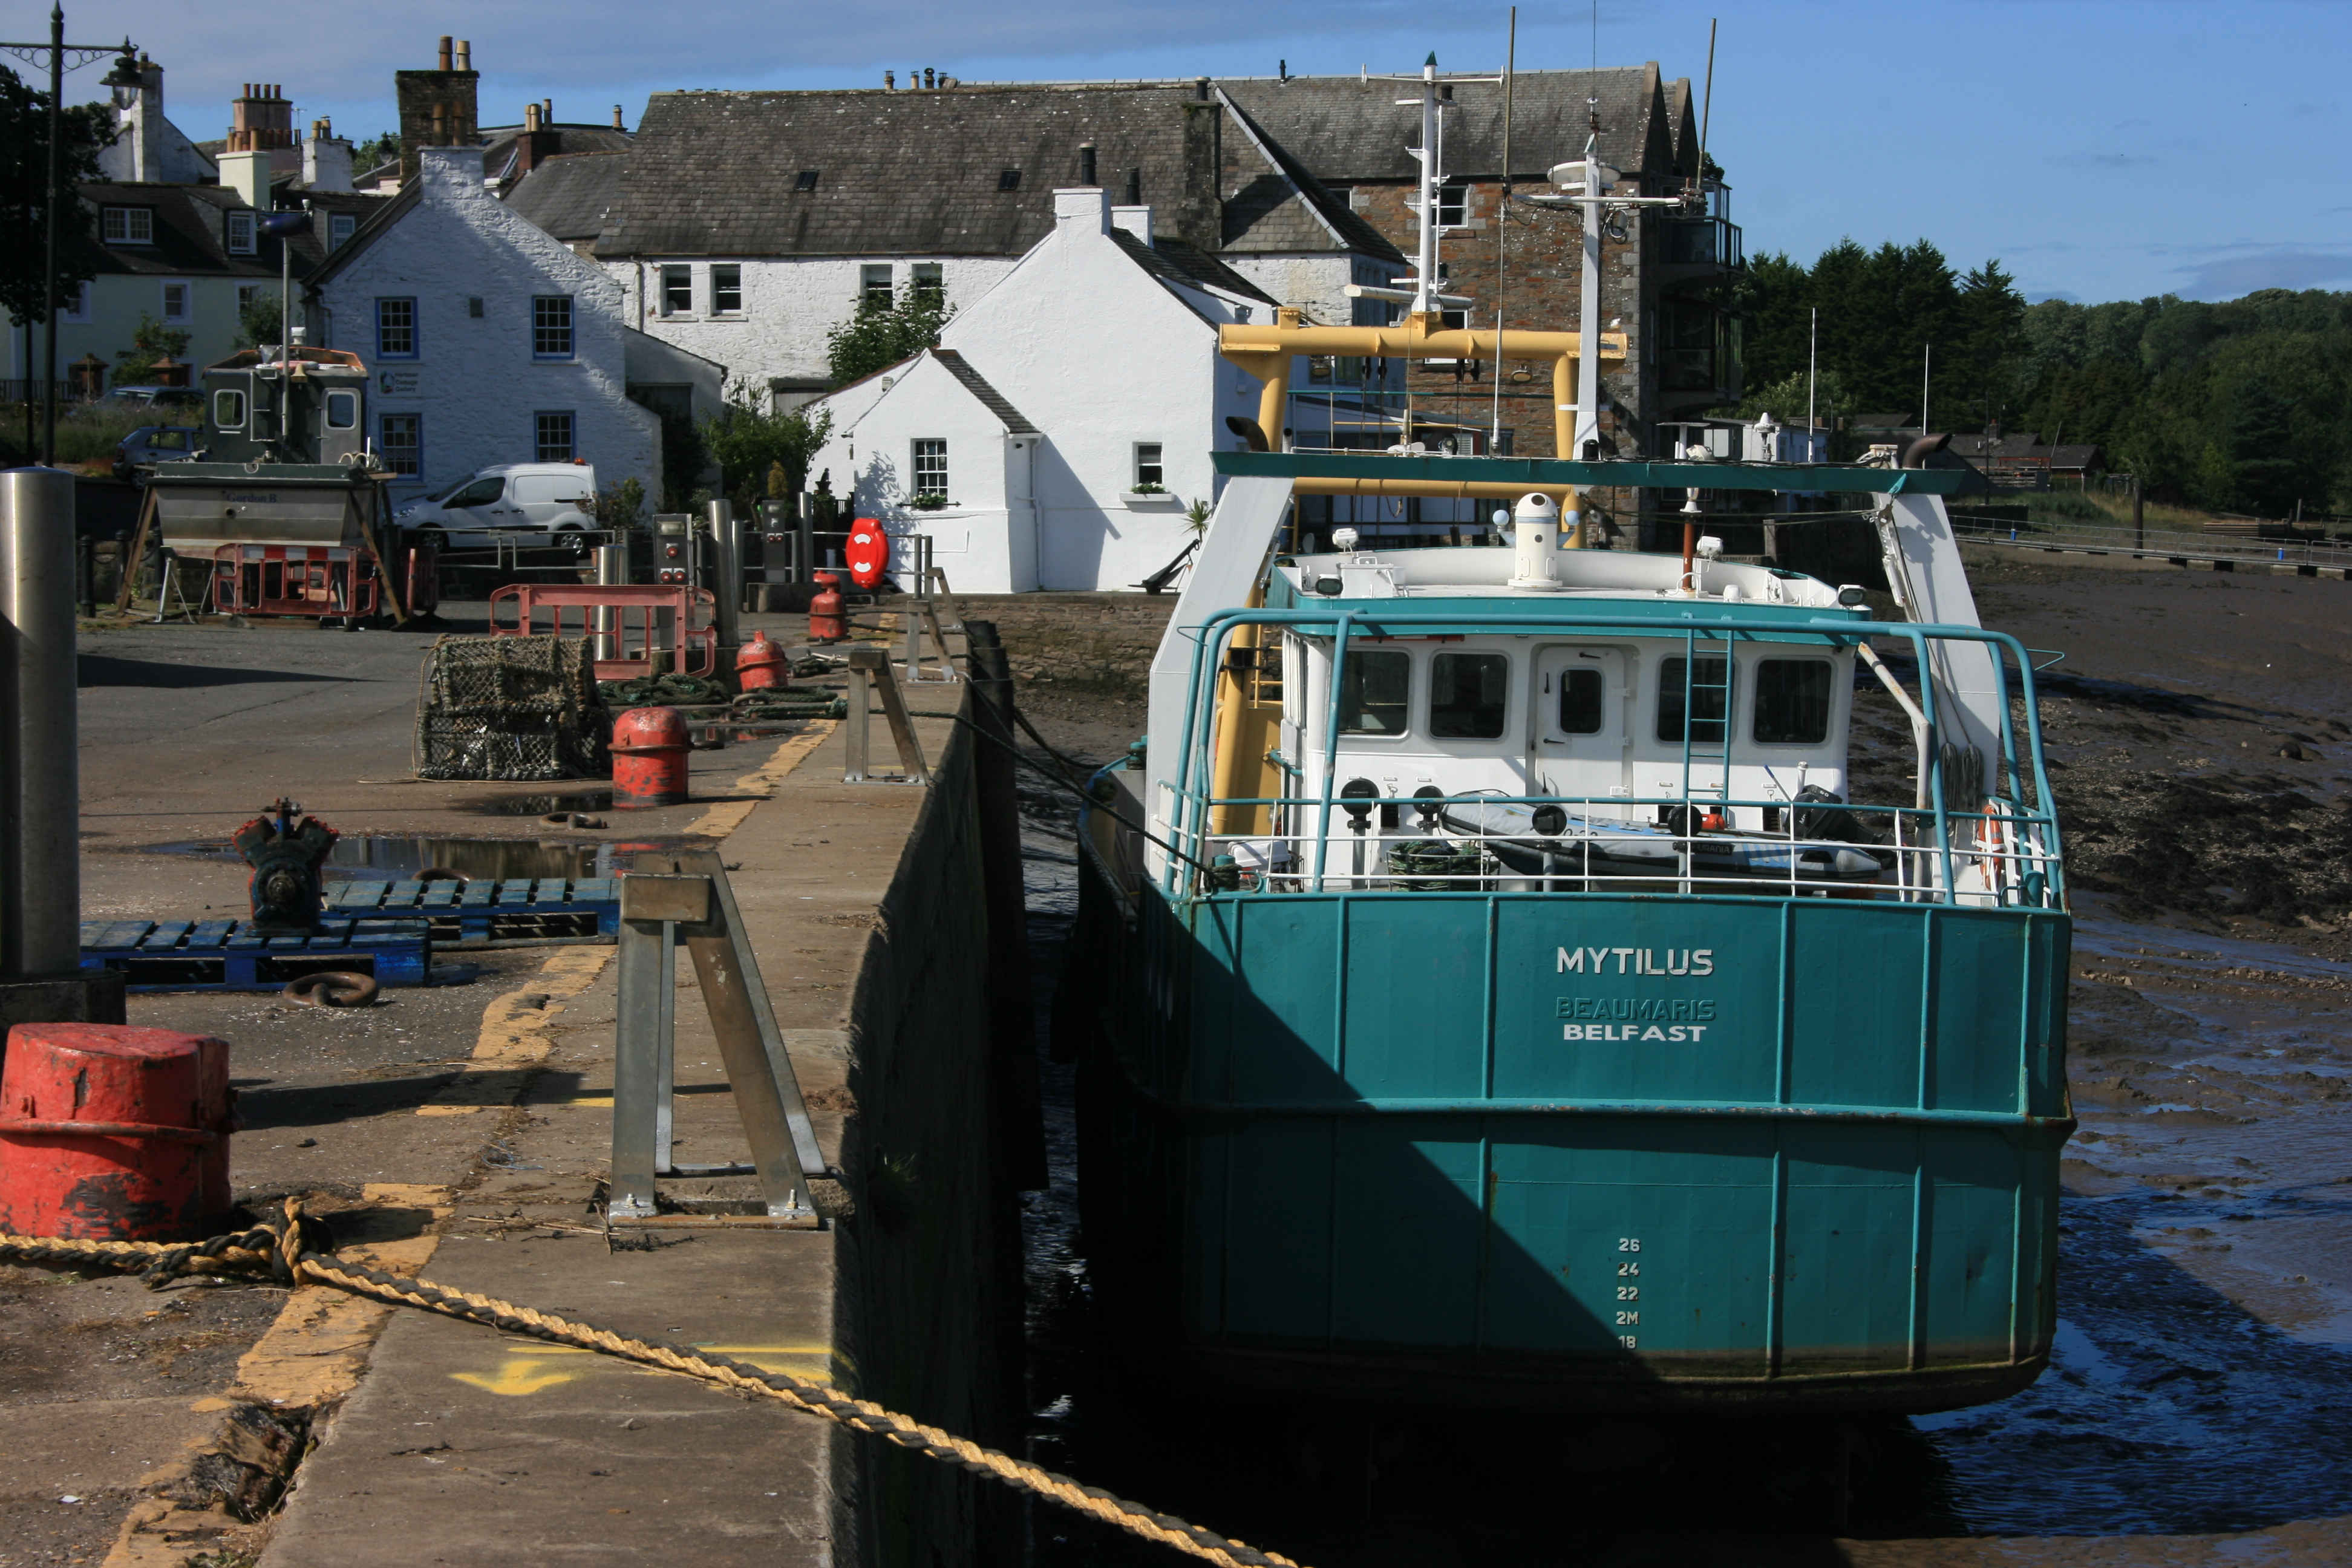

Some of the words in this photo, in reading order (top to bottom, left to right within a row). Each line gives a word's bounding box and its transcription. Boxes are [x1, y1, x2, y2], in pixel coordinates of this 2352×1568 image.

[269, 493, 276, 503] B
[1557, 947, 1713, 975] MYTILUS
[1556, 997, 1716, 1021] BEAUMARIS
[1564, 1024, 1707, 1042] BELFAST
[1618, 1238, 1640, 1252] 26
[1618, 1263, 1639, 1276] 24
[1617, 1287, 1638, 1300] 22
[1616, 1311, 1638, 1325] 2M
[1618, 1336, 1636, 1348] 18
